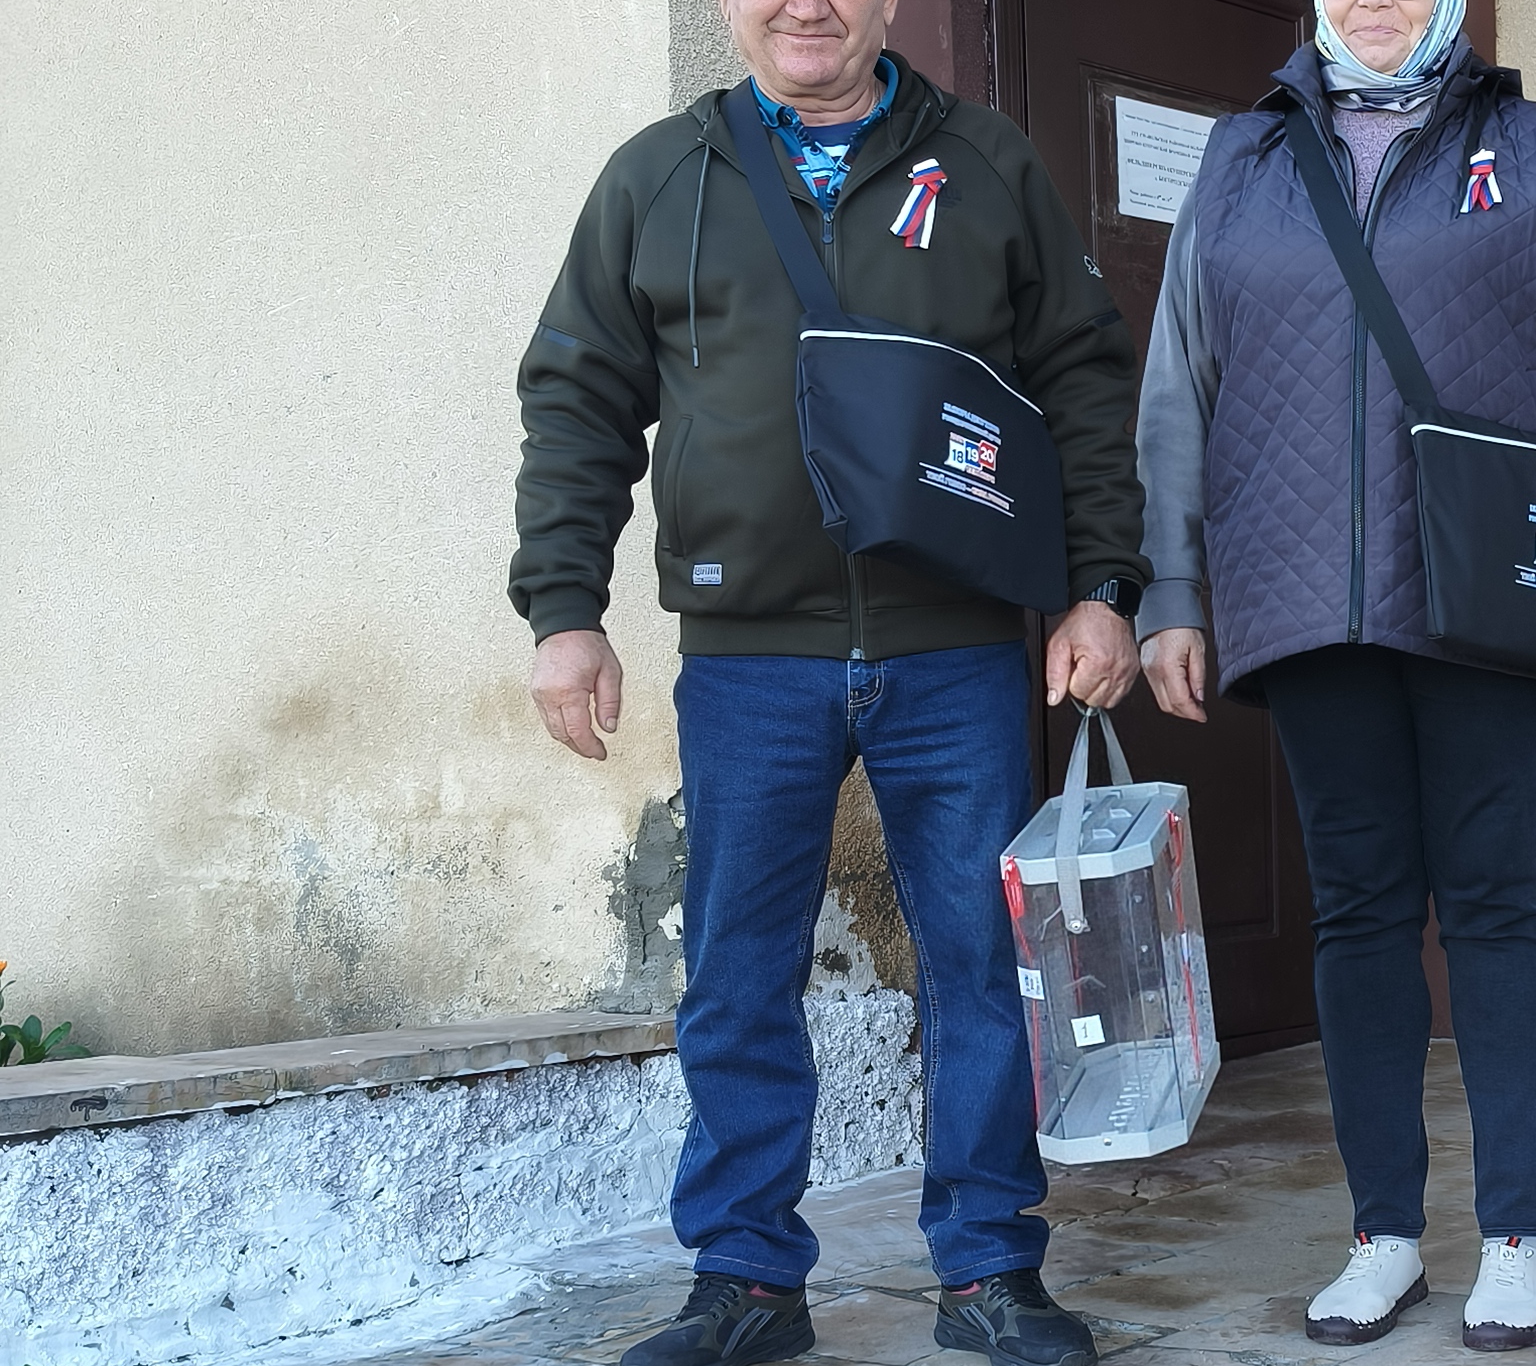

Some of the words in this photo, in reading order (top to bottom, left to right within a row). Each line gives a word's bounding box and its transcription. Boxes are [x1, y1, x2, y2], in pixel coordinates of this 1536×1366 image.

[952, 448, 964, 464] 18
[966, 446, 979, 463] 19
[980, 446, 994, 463] 20
